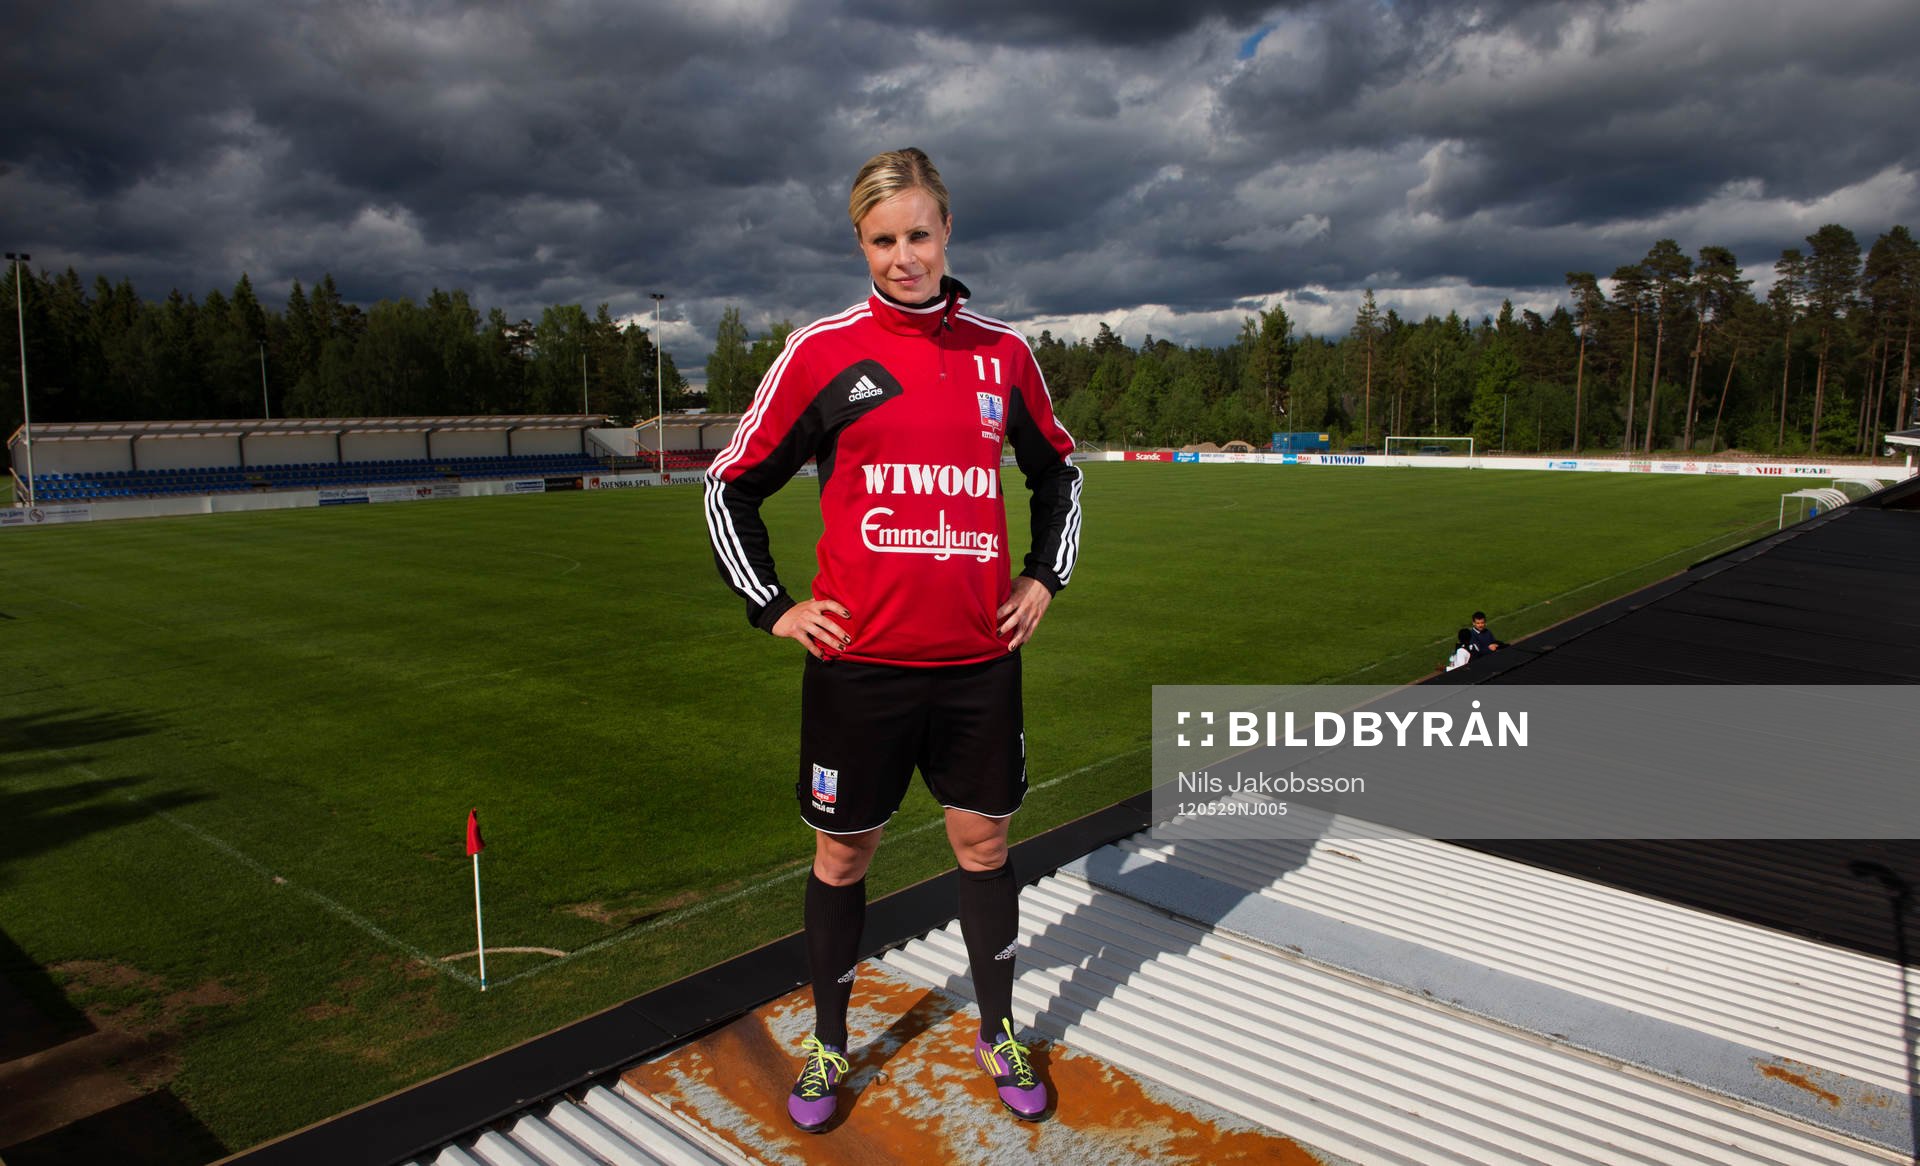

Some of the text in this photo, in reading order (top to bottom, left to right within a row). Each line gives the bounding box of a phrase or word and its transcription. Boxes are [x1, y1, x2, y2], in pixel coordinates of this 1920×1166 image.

[973, 355, 1001, 384] 11
[848, 387, 883, 402] adidas
[1135, 452, 1161, 461] Scandic
[1320, 455, 1365, 465] WIWOOD
[601, 479, 651, 489] SVENSKA SPEL
[671, 476, 701, 484] SVENSKA
